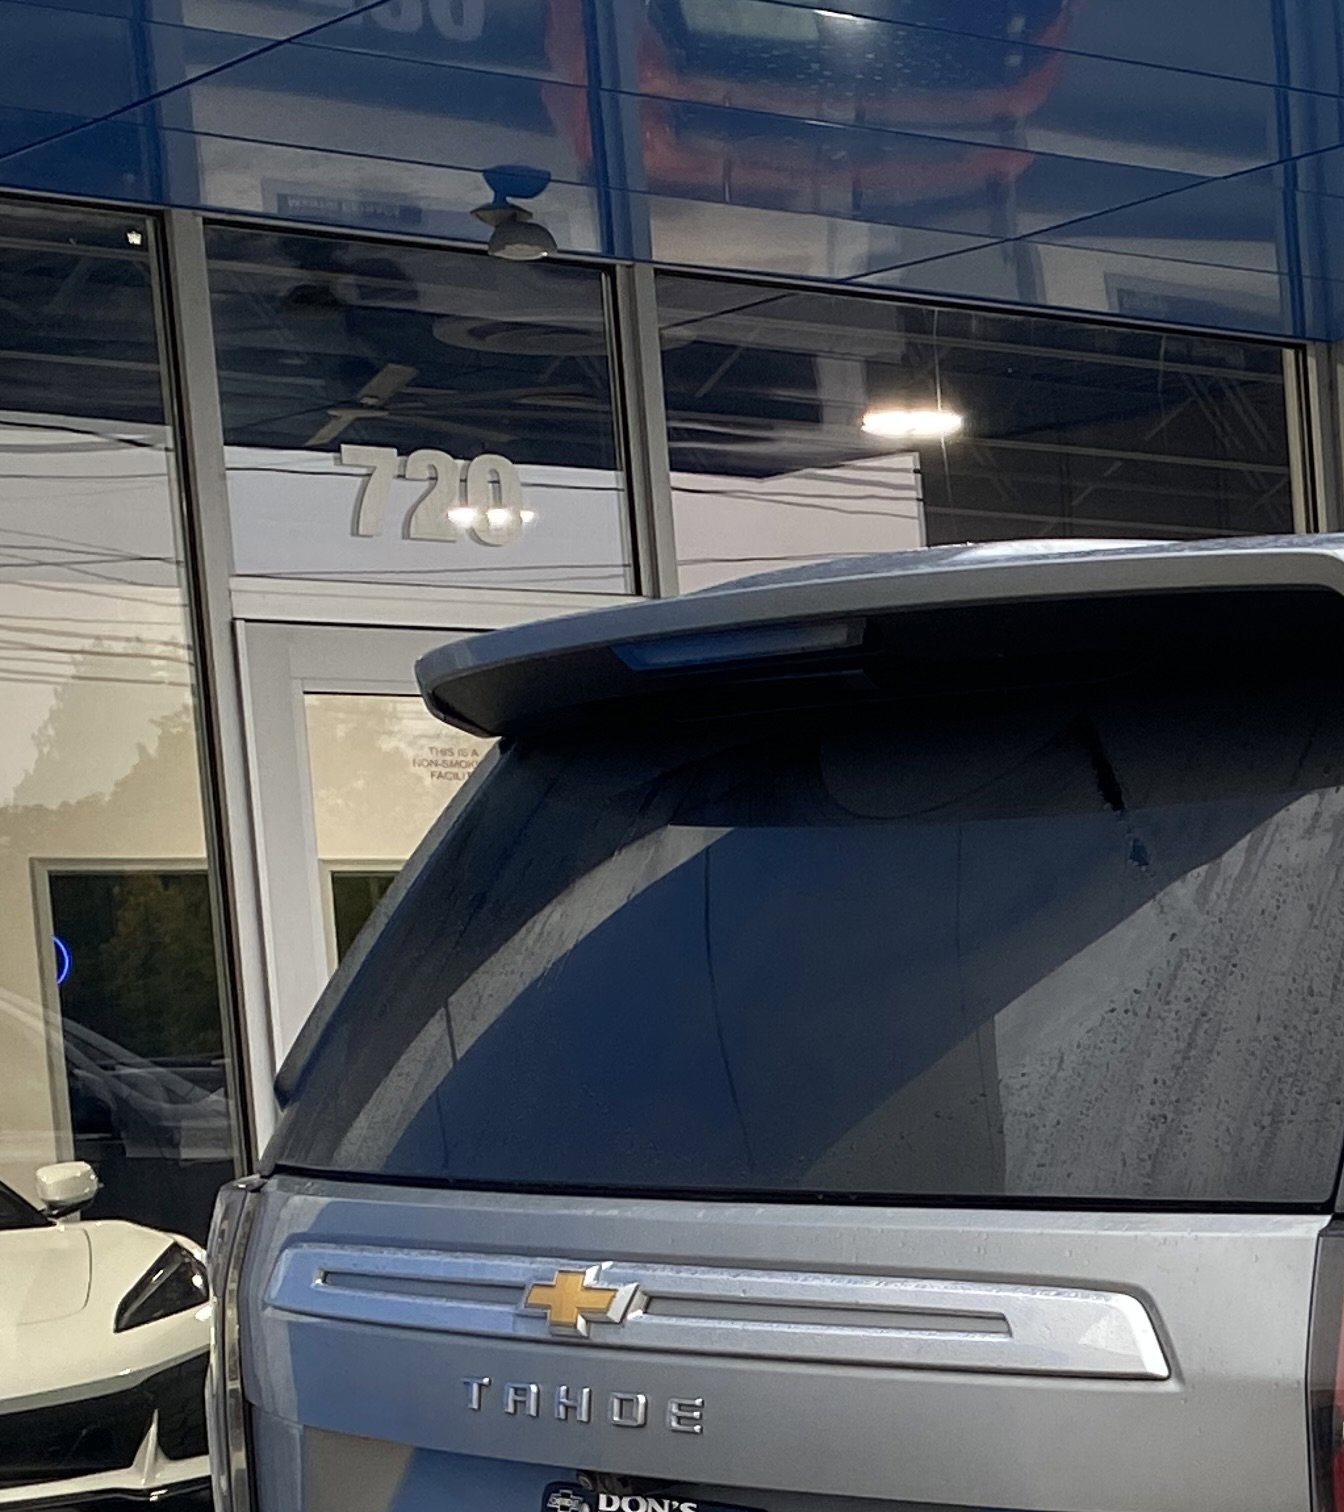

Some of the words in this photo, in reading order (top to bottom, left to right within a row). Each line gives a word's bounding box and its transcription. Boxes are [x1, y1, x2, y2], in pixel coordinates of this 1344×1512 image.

[335, 444, 524, 547] 720
[428, 746, 455, 757] THIS
[458, 748, 469, 758] IS
[471, 749, 480, 757] A
[412, 758, 477, 769] NON-SMOK
[430, 770, 471, 781] FACILI
[461, 1376, 704, 1434] TAHOE
